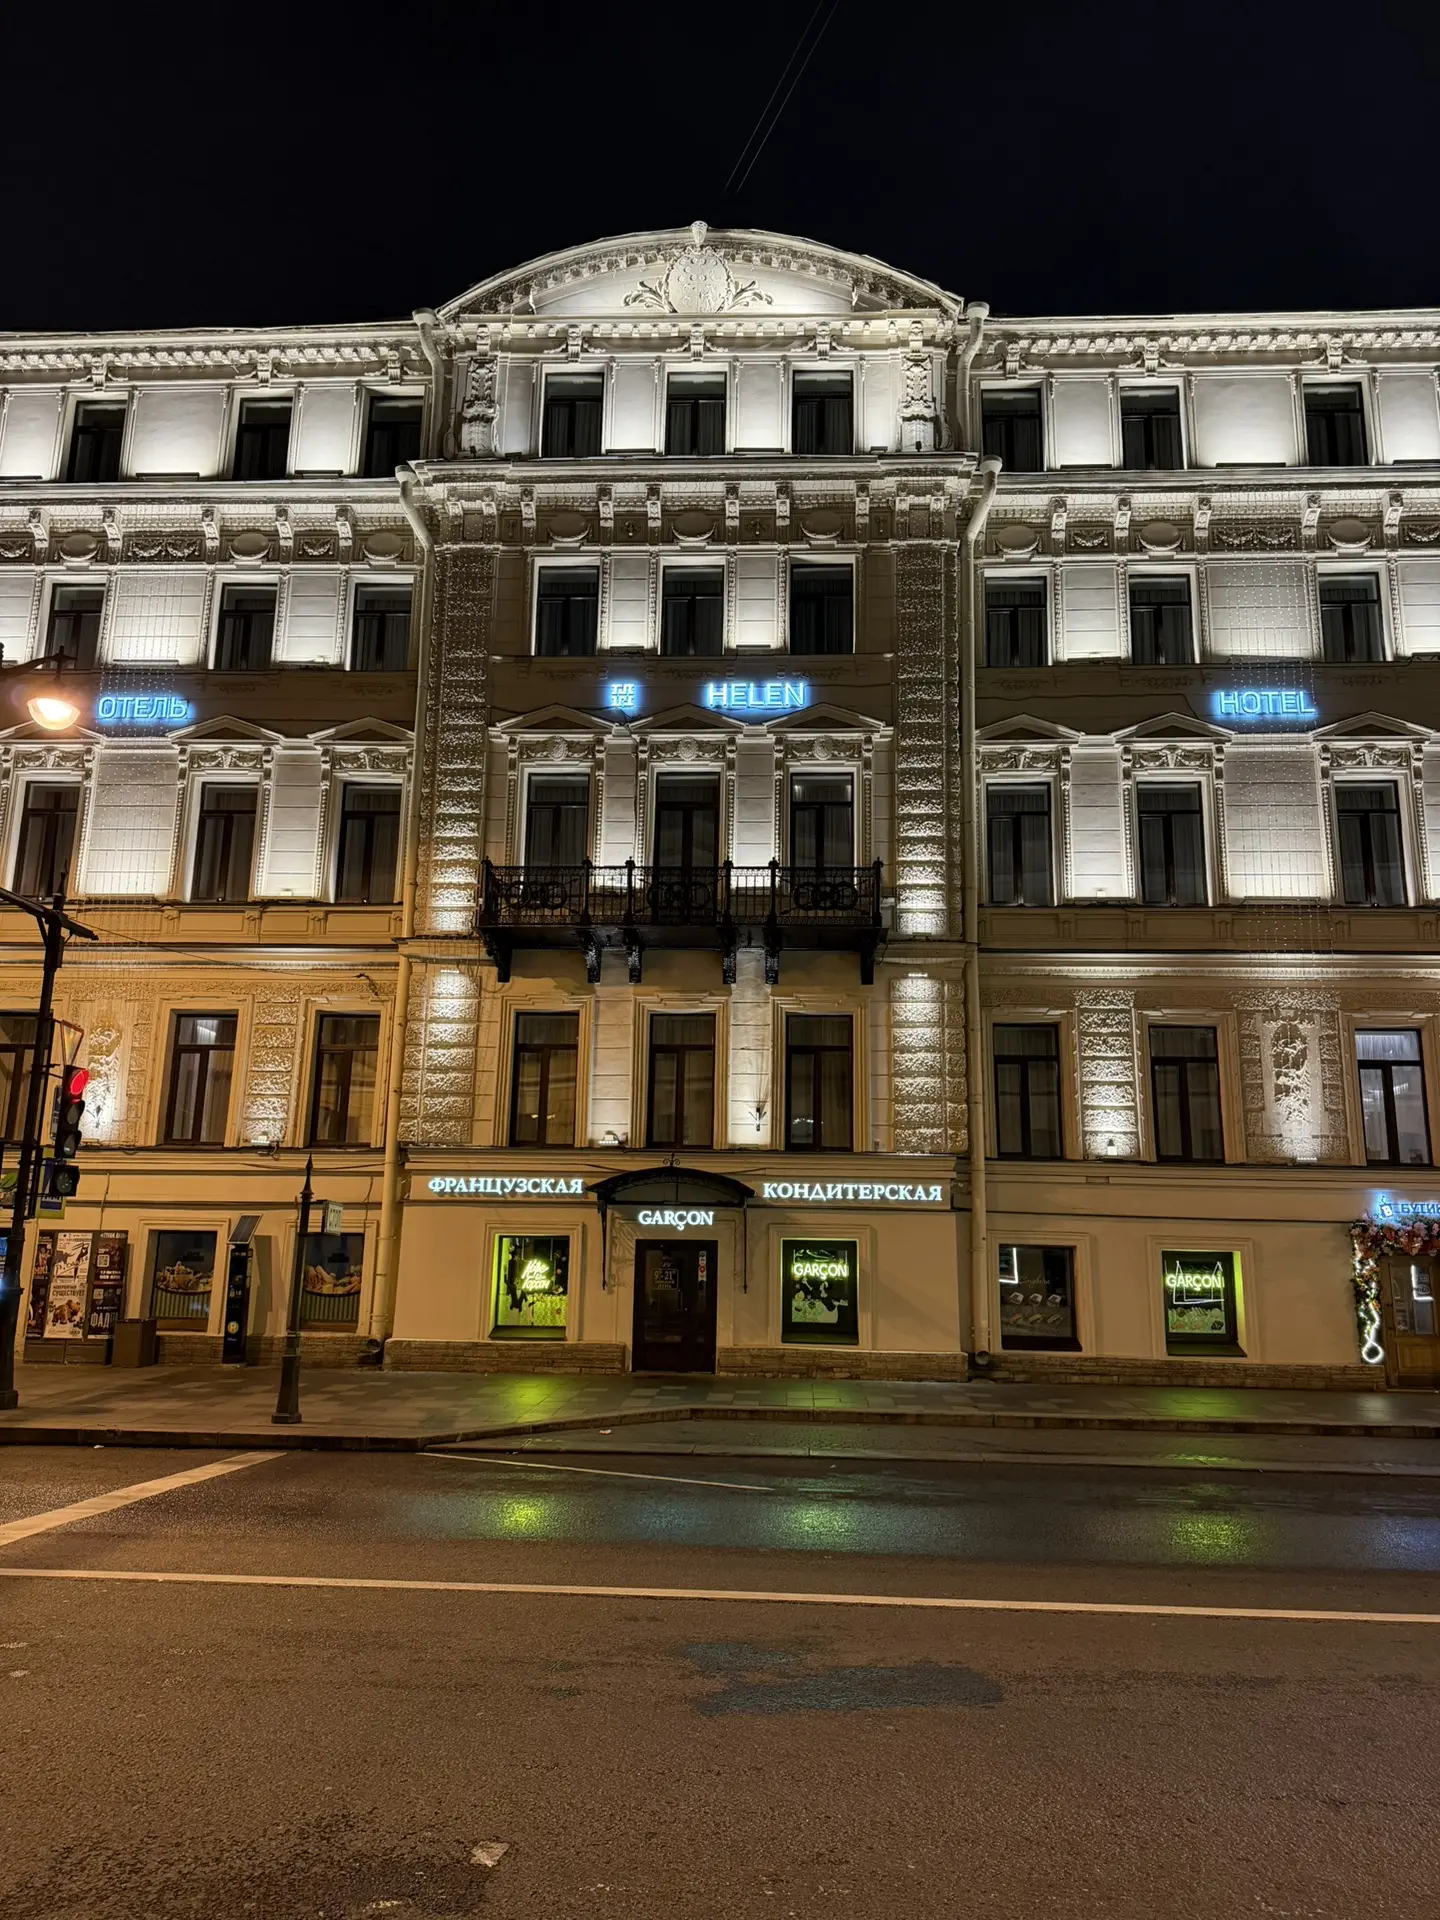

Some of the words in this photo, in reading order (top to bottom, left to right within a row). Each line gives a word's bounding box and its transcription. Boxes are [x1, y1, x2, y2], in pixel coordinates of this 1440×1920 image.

[709, 683, 804, 706] HELEN
[1219, 691, 1316, 715] HOTEL
[98, 696, 188, 719] ОТЕЛЬ
[428, 1176, 584, 1195] ФРАНЦУЗСКАЯ
[762, 1182, 943, 1202] КОНДИТЕРСКАЯ
[638, 1210, 715, 1231] GARÇON
[793, 1262, 848, 1281] GARÇON
[1165, 1273, 1221, 1292] GARÇON
